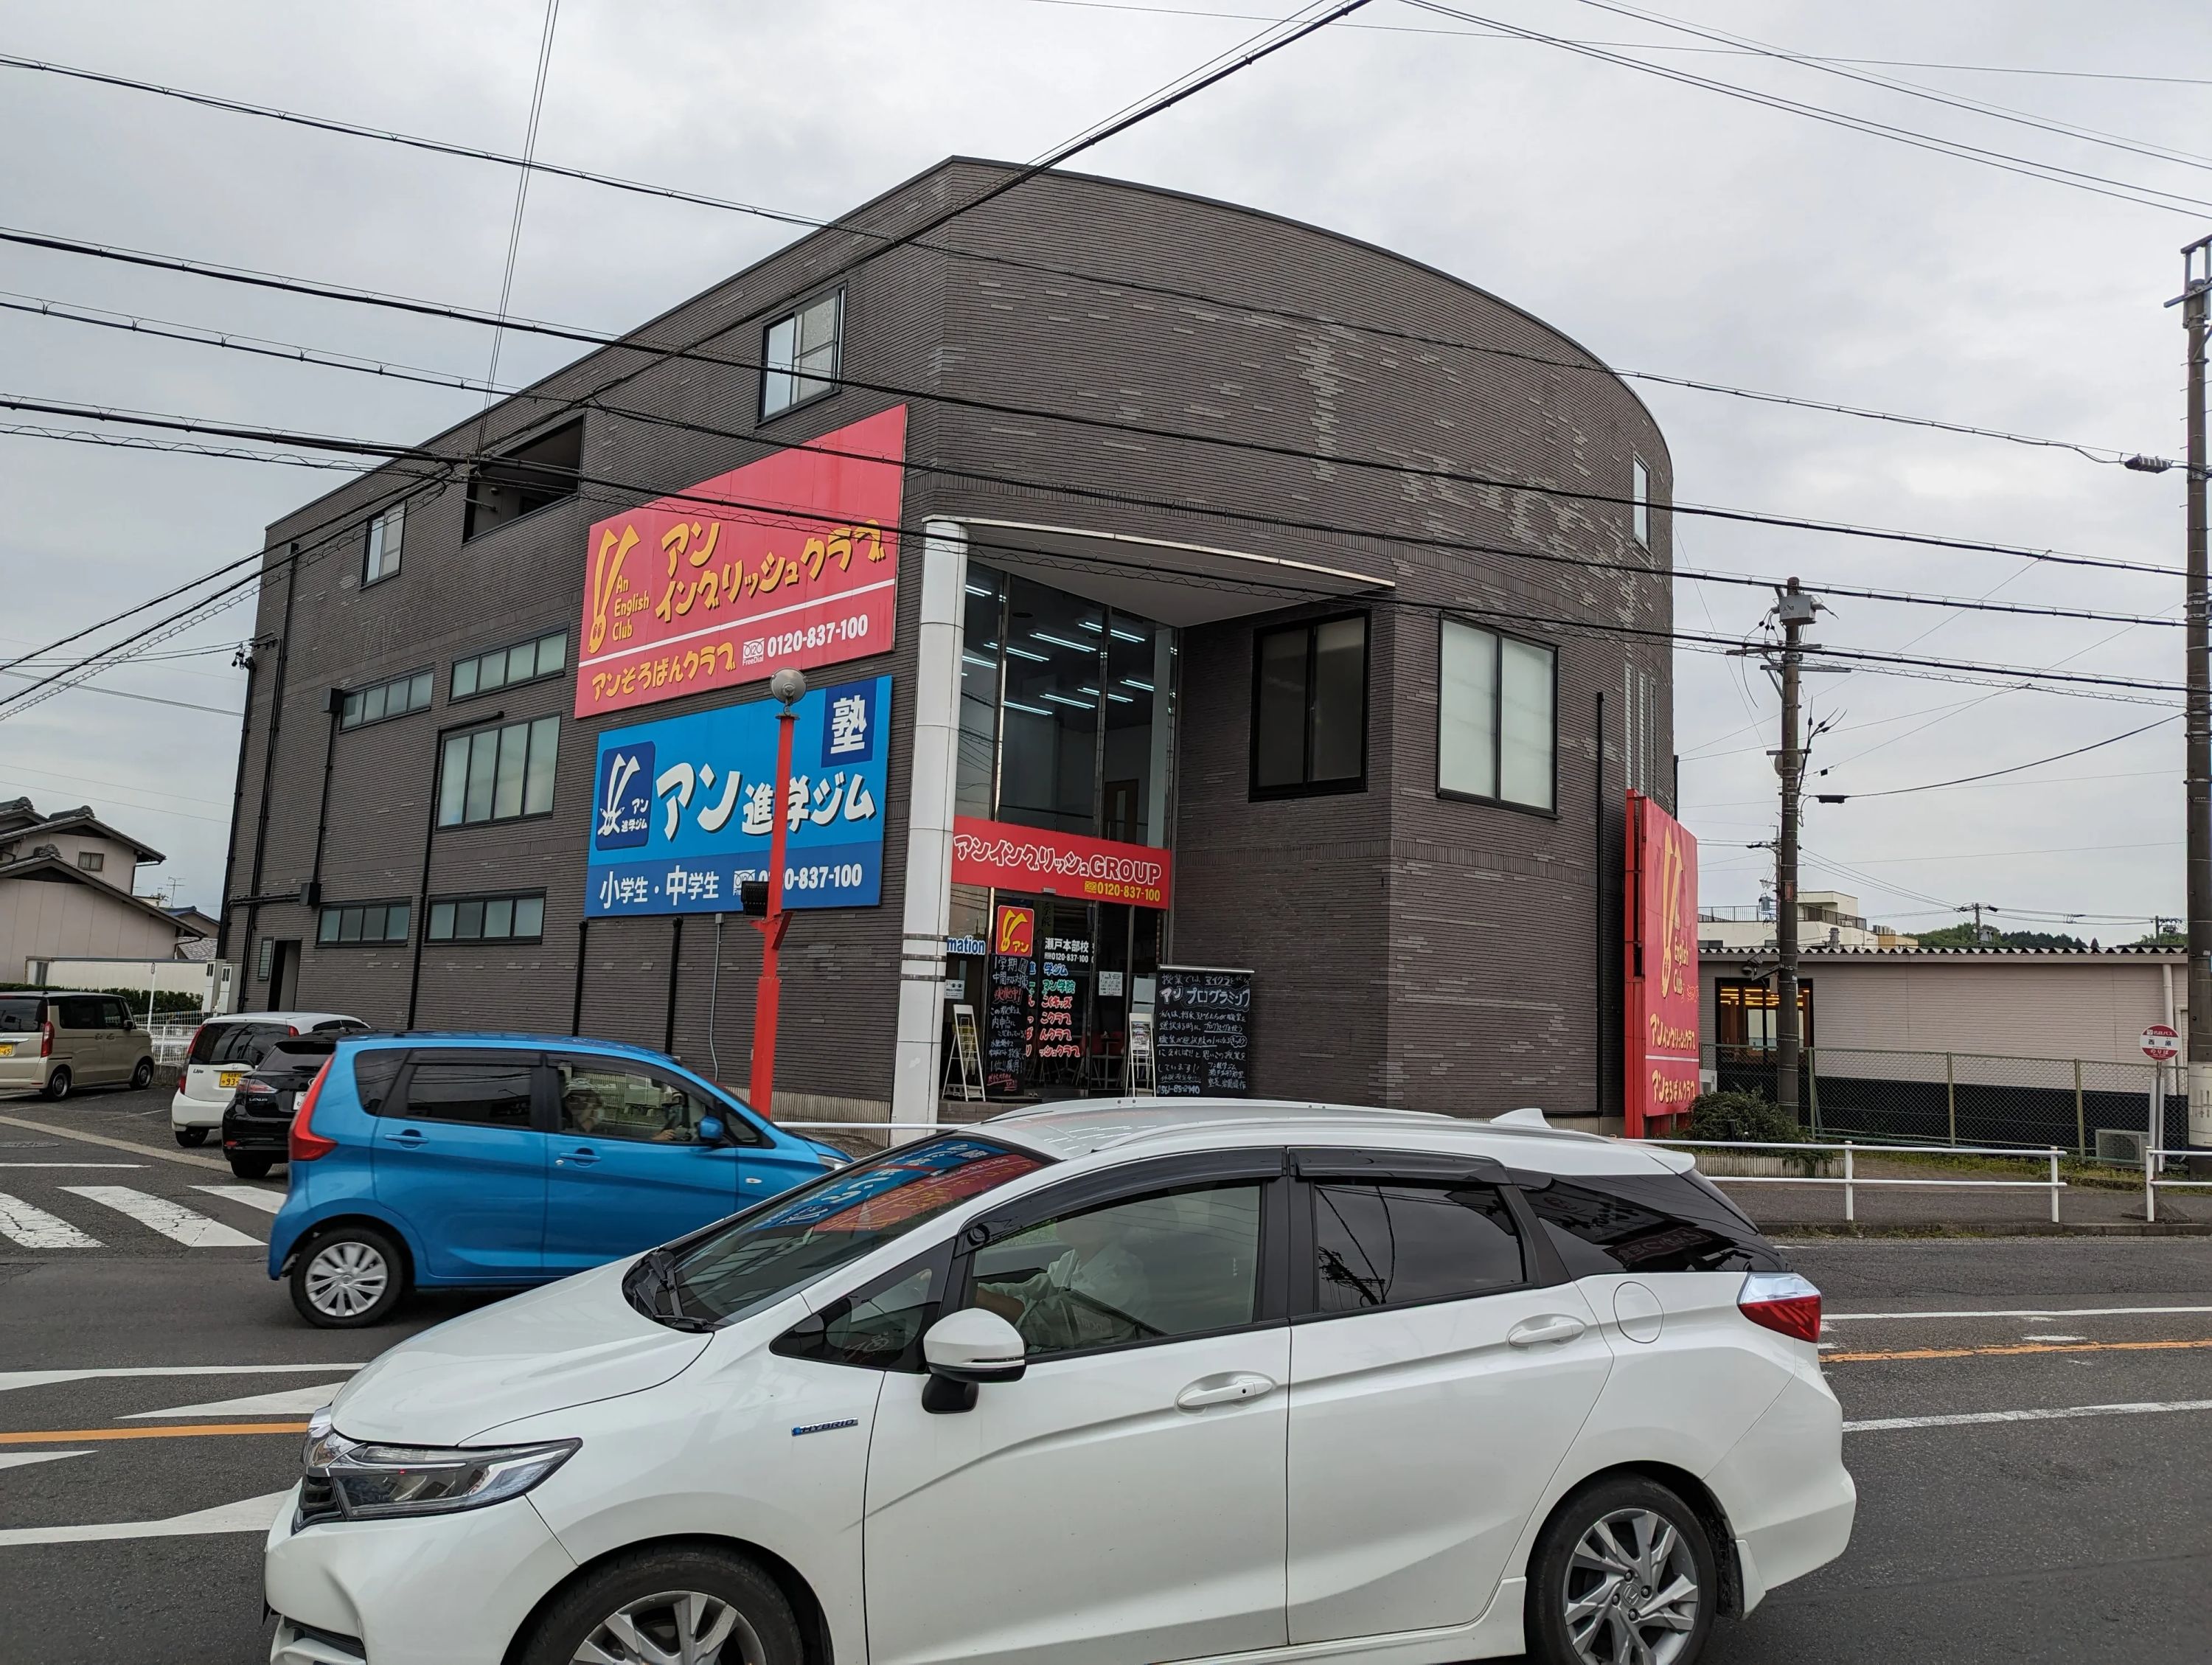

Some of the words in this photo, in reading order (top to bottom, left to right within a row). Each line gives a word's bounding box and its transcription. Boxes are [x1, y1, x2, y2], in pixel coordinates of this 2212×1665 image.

[661, 521, 720, 577] アン
[655, 519, 887, 623] イングリッシュクラブ
[616, 575, 629, 594] An
[615, 591, 650, 617] English
[613, 619, 633, 641] Club
[767, 614, 869, 658] 0120-837-100
[592, 642, 737, 701] アンそろばんクラブ
[830, 695, 867, 754] 塾
[631, 798, 649, 814] アン
[655, 762, 876, 842] アン進学ジム
[621, 818, 647, 832] 進学ジム
[599, 865, 720, 909] 小学生・中学生
[759, 863, 863, 891] 00-837-100
[1097, 881, 1161, 902] 0120-837-100
[1012, 940, 1029, 953] アン
[1045, 937, 1089, 953] 瀬戸本部校
[1051, 953, 1089, 963] 0120-837-100
[801, 1419, 855, 1433] HYBRID
